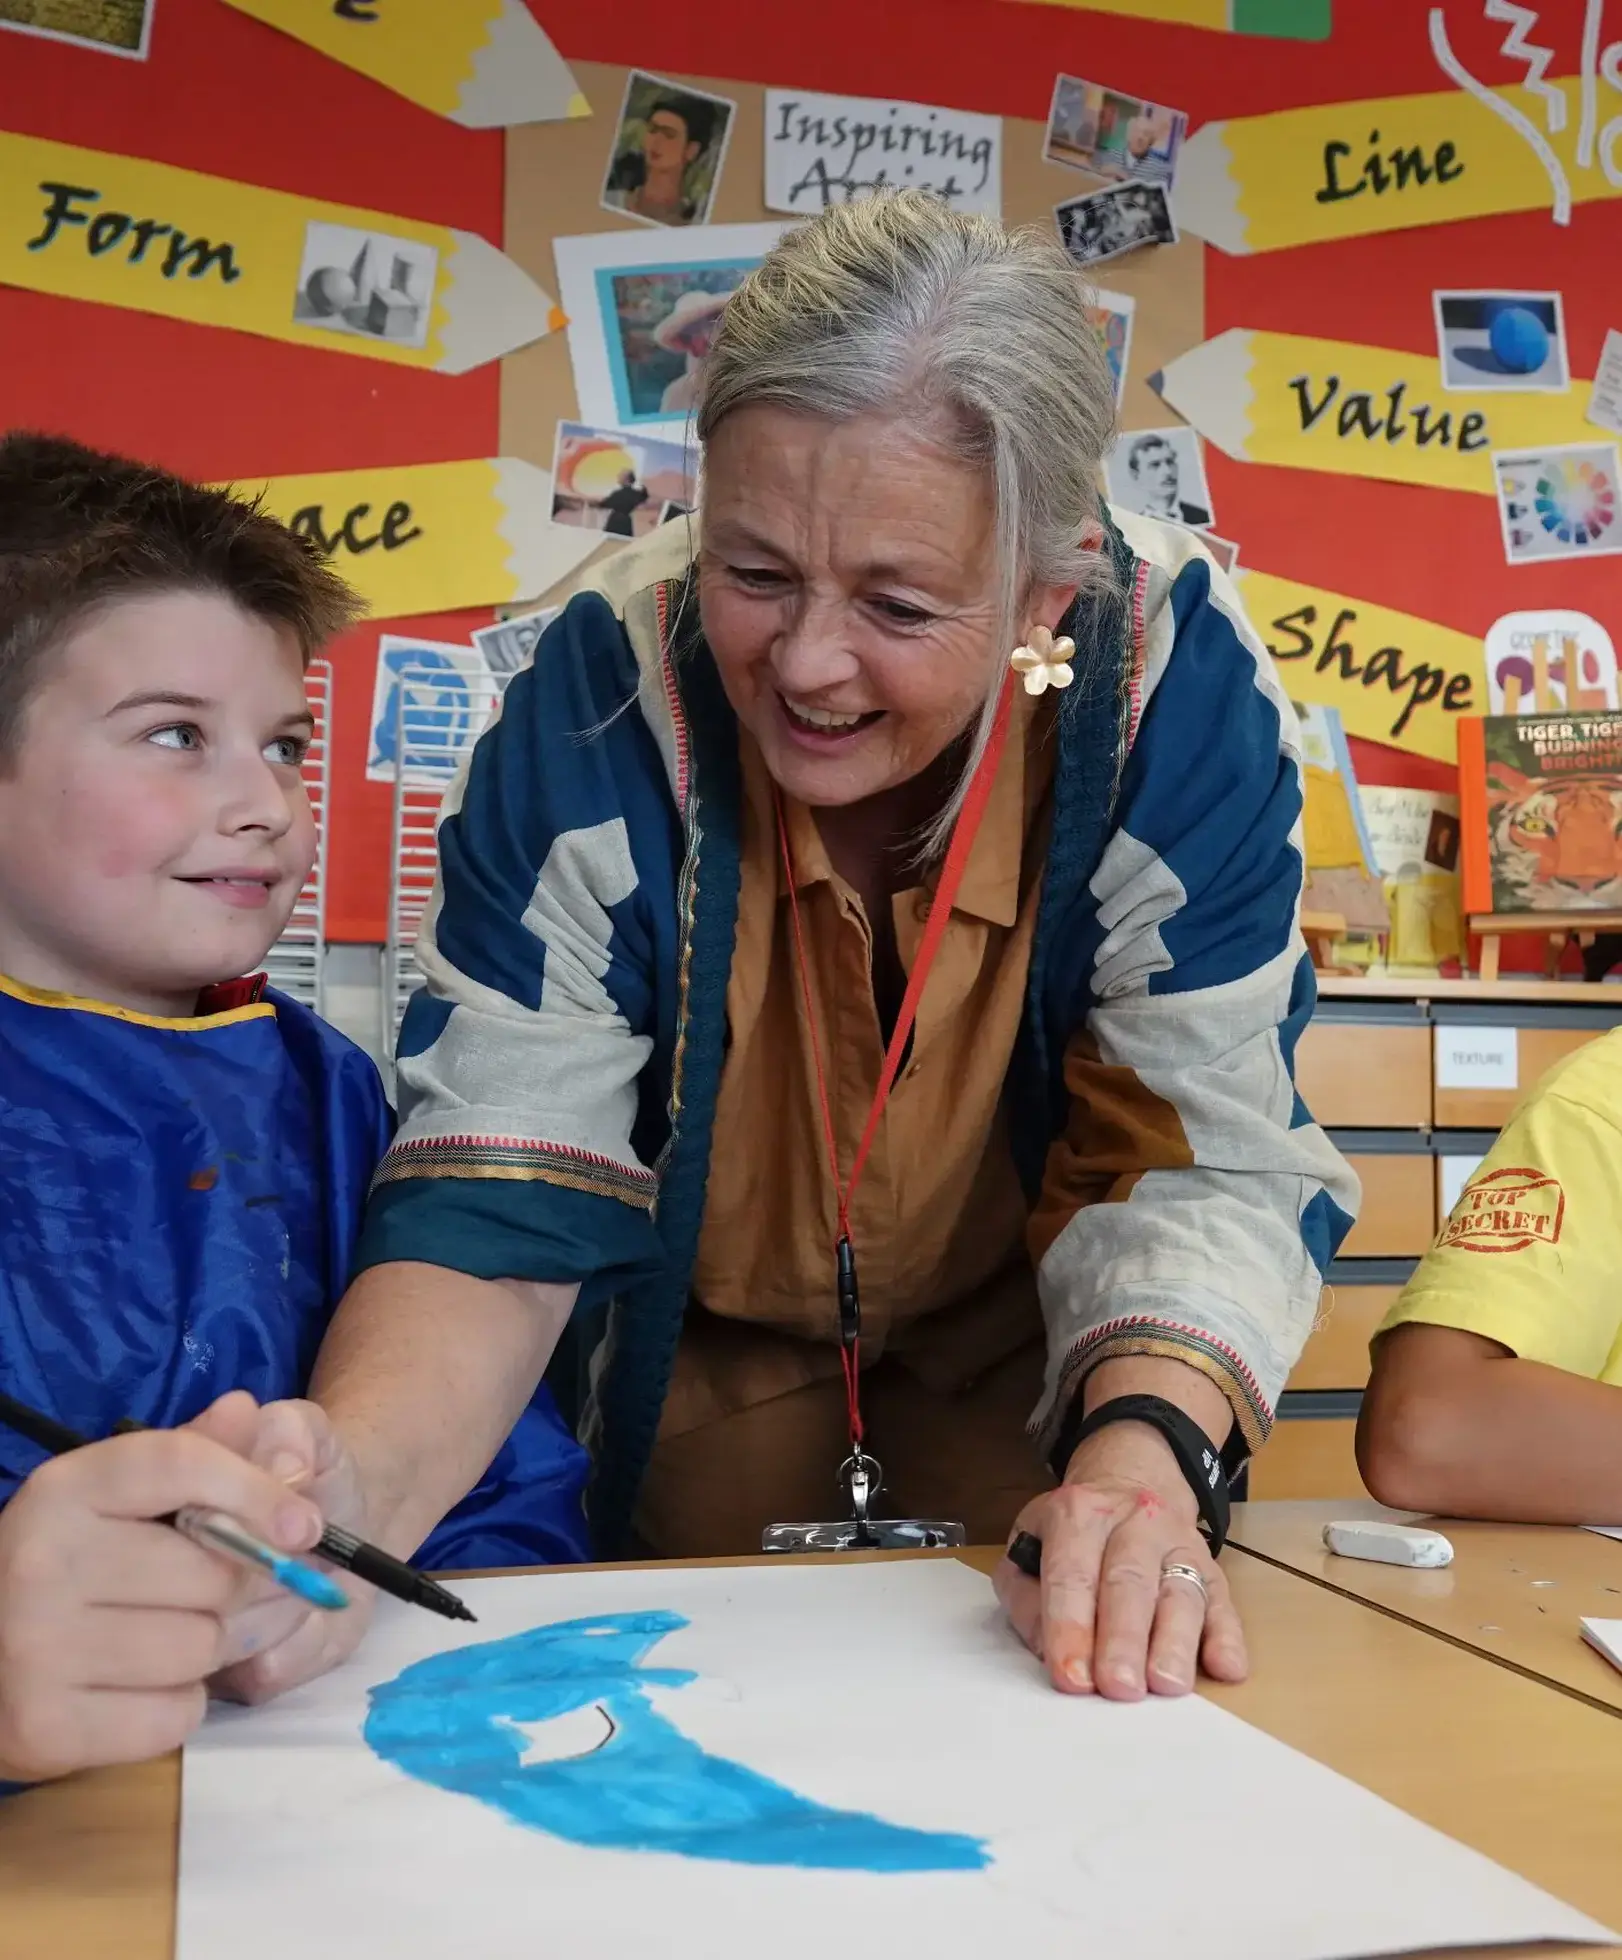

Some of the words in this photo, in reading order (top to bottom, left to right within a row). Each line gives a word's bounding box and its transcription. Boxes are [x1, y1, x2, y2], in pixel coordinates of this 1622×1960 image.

[774, 102, 993, 193] Inspiring
[1315, 129, 1464, 203] Line
[27, 181, 240, 283] Form
[1288, 375, 1491, 453] Value
[1267, 605, 1474, 737] Shape
[1449, 1210, 1550, 1237] SECRET
[1471, 1191, 1527, 1210] TOP
